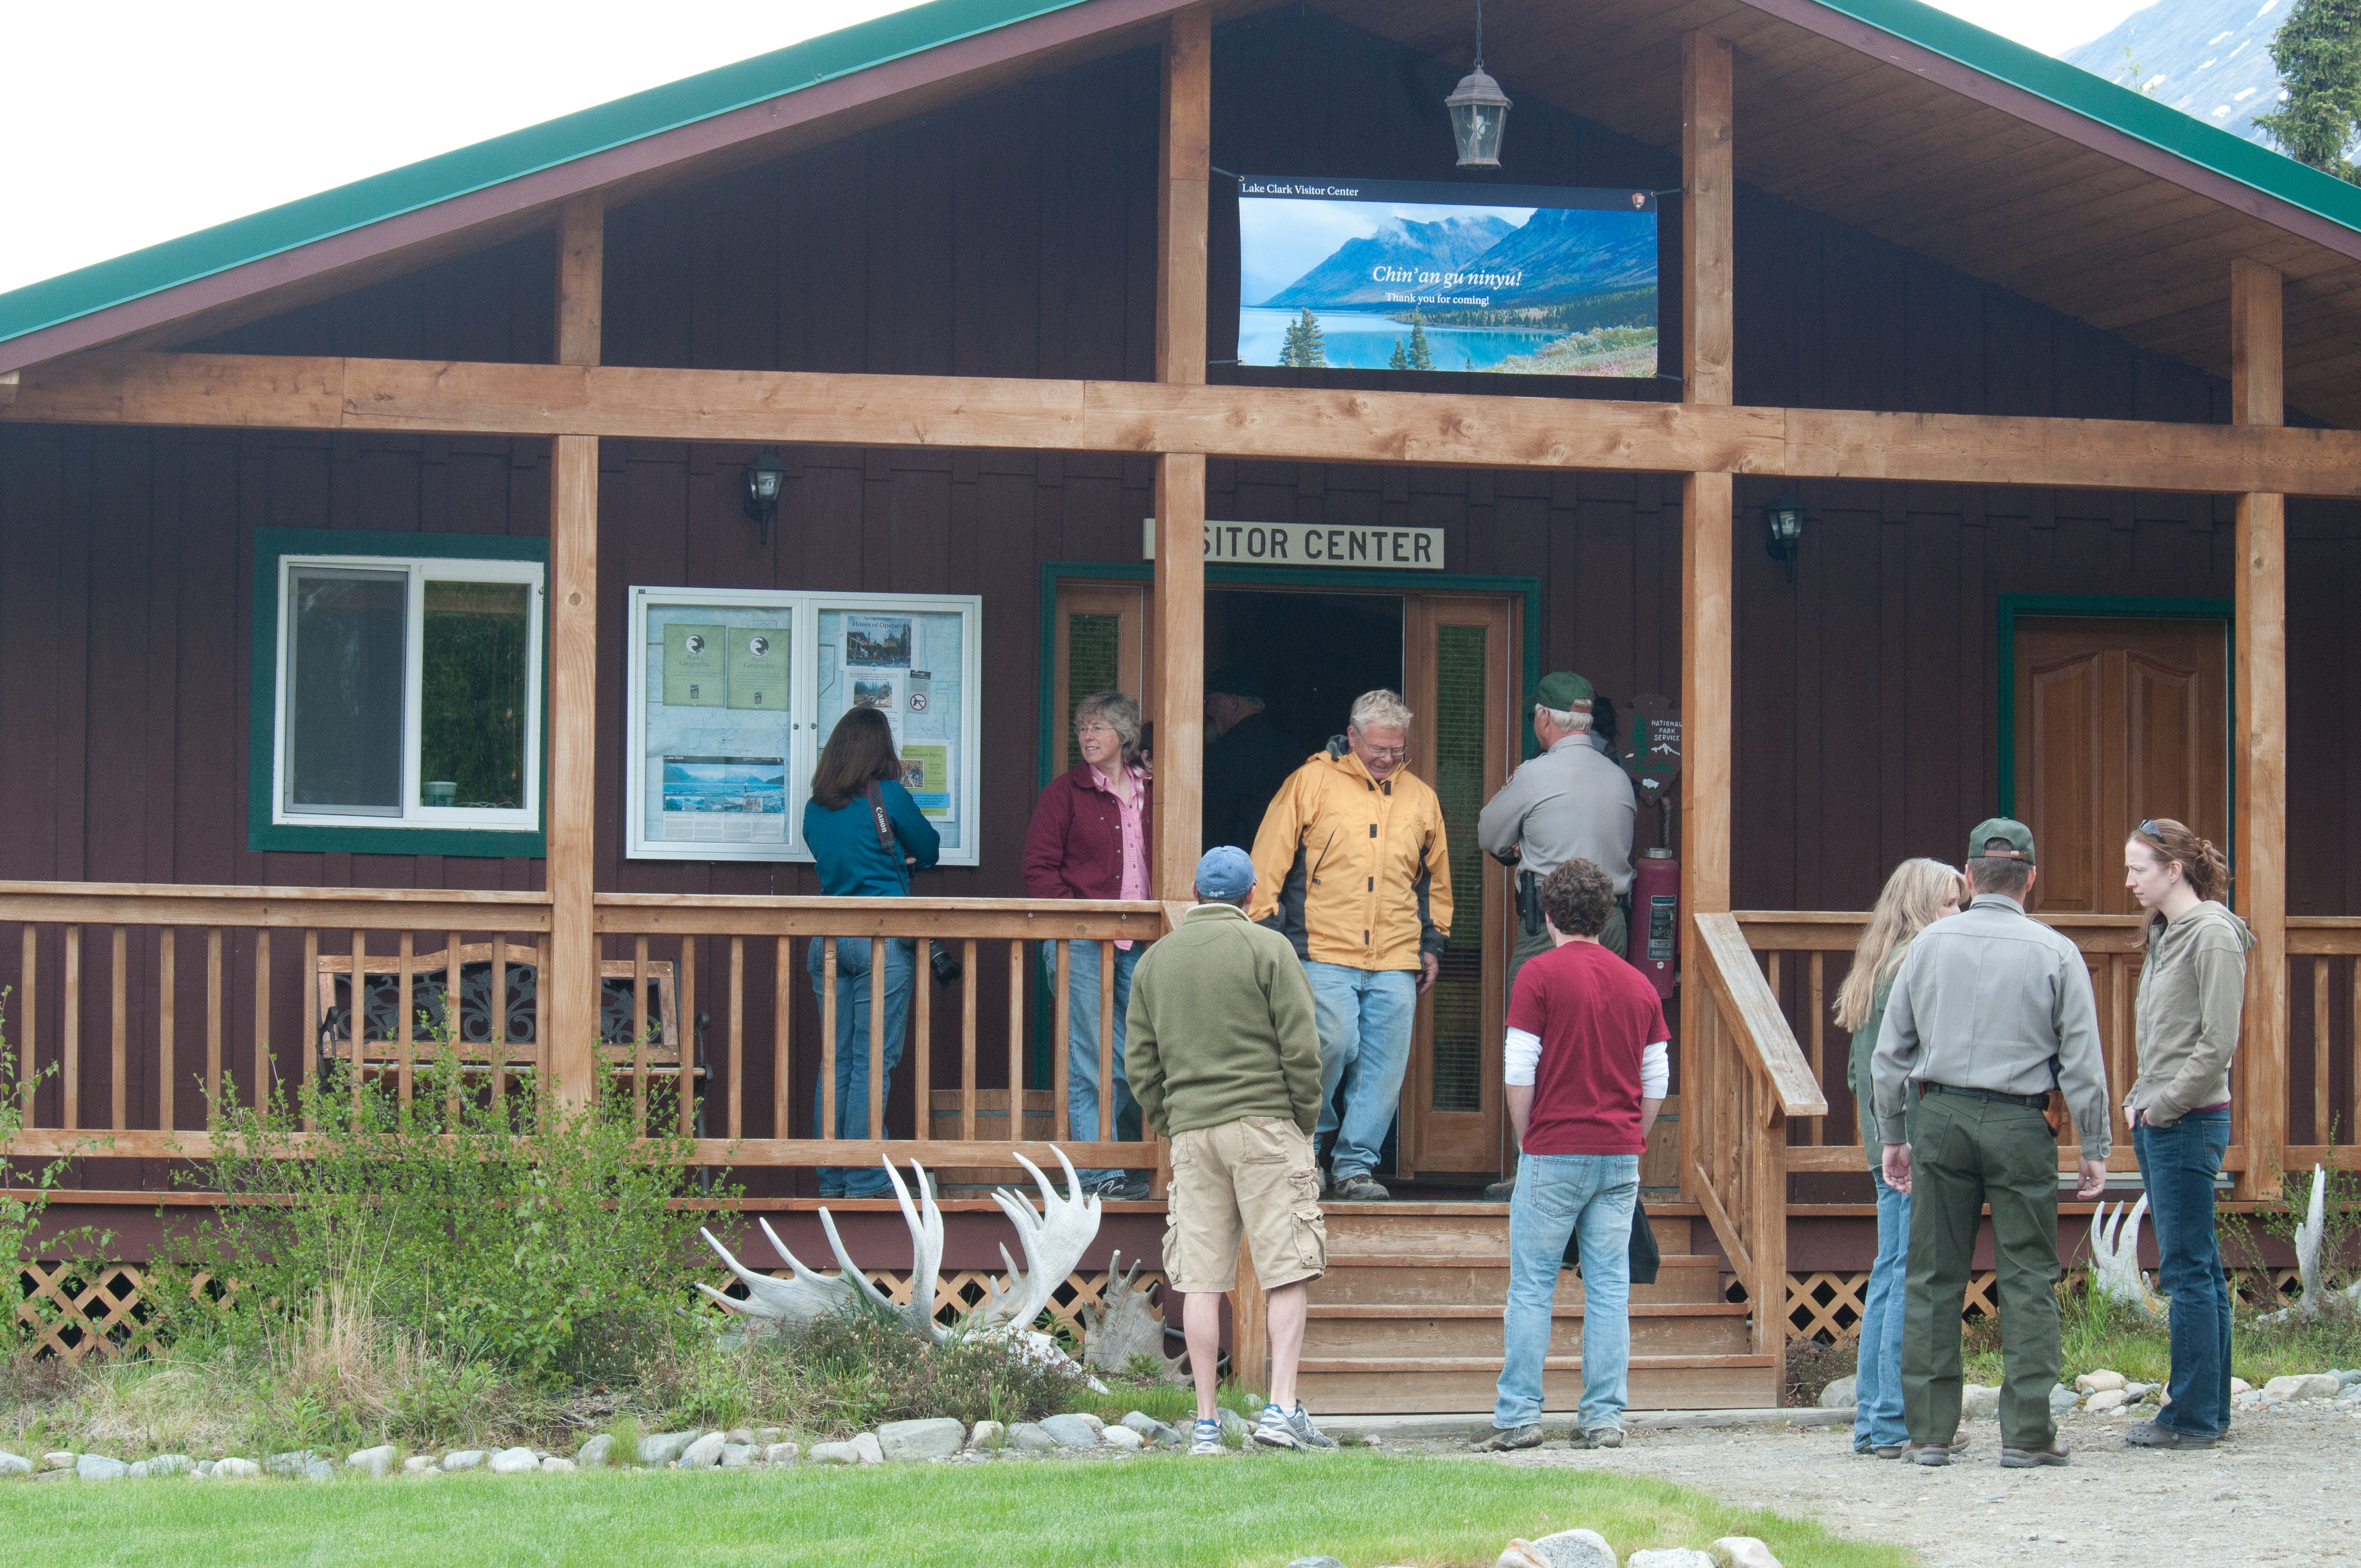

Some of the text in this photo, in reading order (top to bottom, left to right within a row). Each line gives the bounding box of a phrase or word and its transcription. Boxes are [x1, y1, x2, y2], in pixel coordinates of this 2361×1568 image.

[1242, 183, 1359, 196] Lake Clark Visitor Center
[1443, 272, 1464, 288] gu
[1468, 269, 1522, 290] ninyu!
[1385, 292, 1489, 307] Thank you for coming!
[1304, 530, 1432, 563] CENTER
[875, 807, 887, 833] Canon
